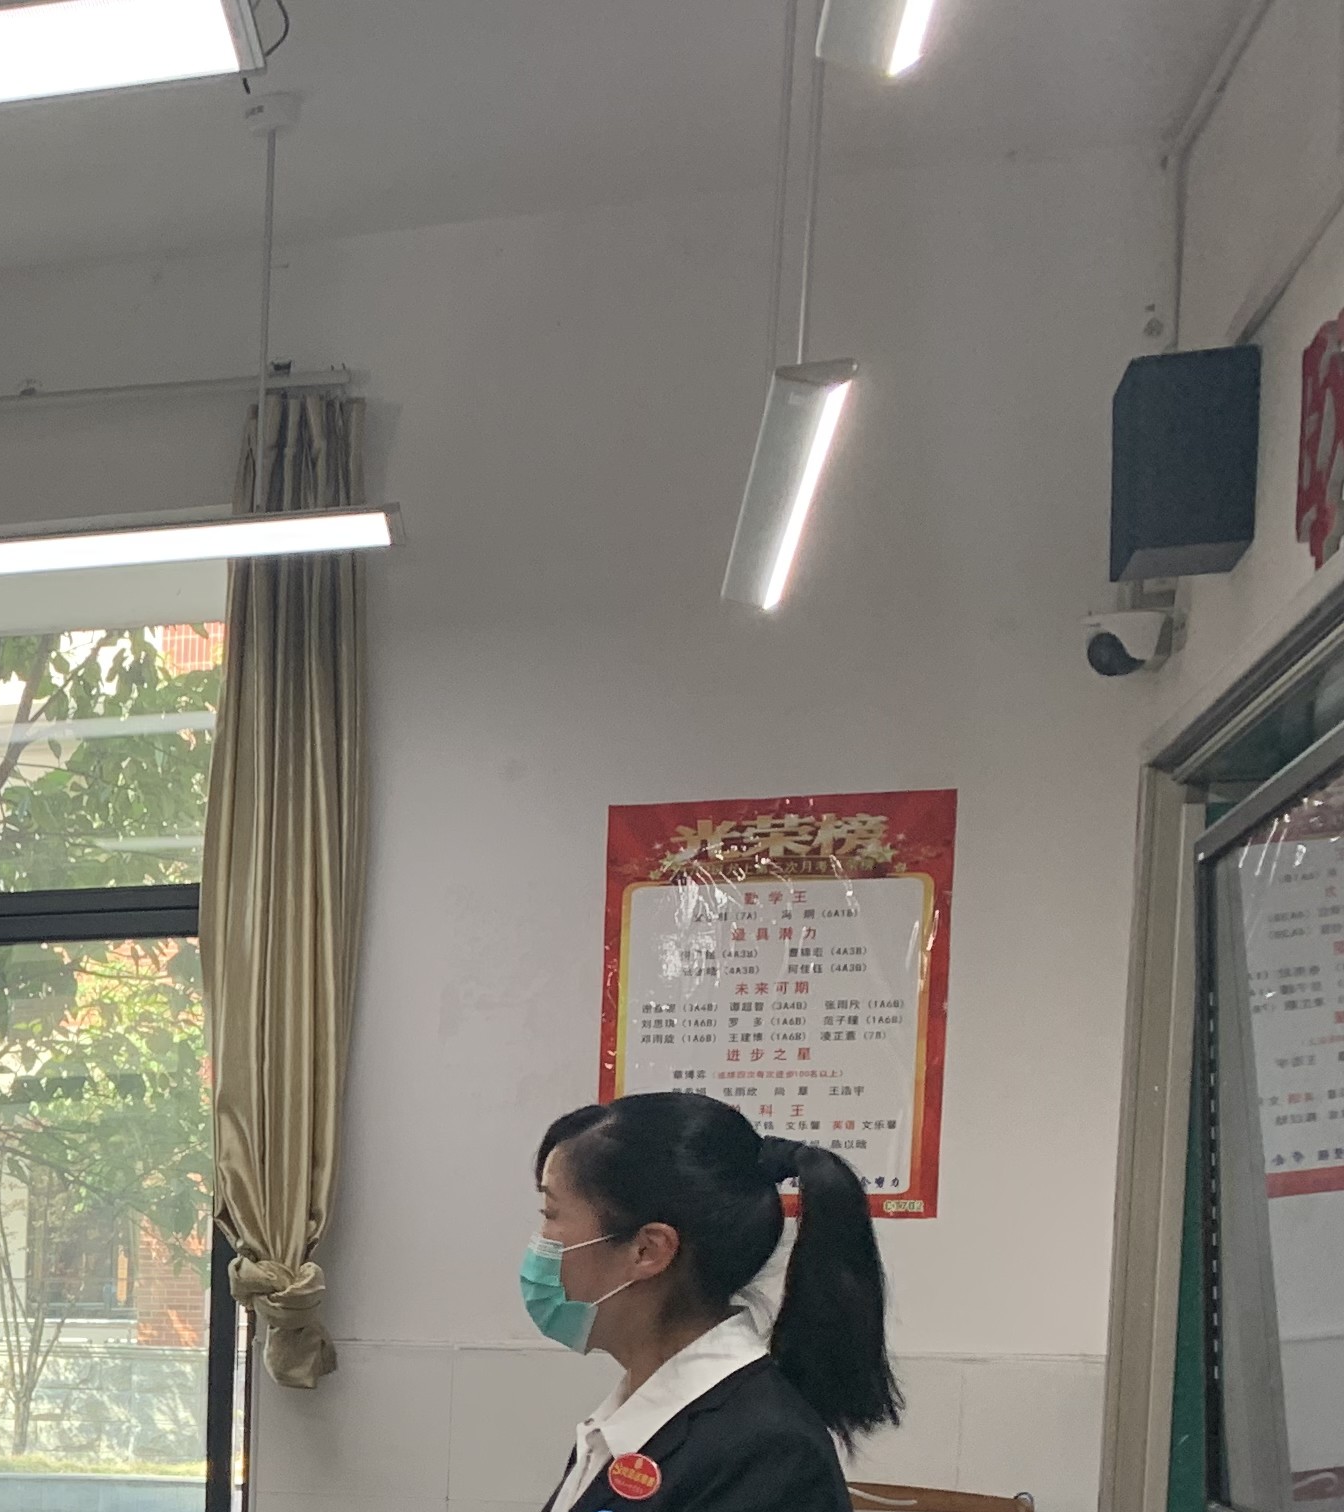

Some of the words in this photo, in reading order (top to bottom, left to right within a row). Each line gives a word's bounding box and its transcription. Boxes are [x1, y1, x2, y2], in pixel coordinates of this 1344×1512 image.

[735, 981, 810, 996] 未来可期
[726, 1047, 812, 1062] 进步之星
